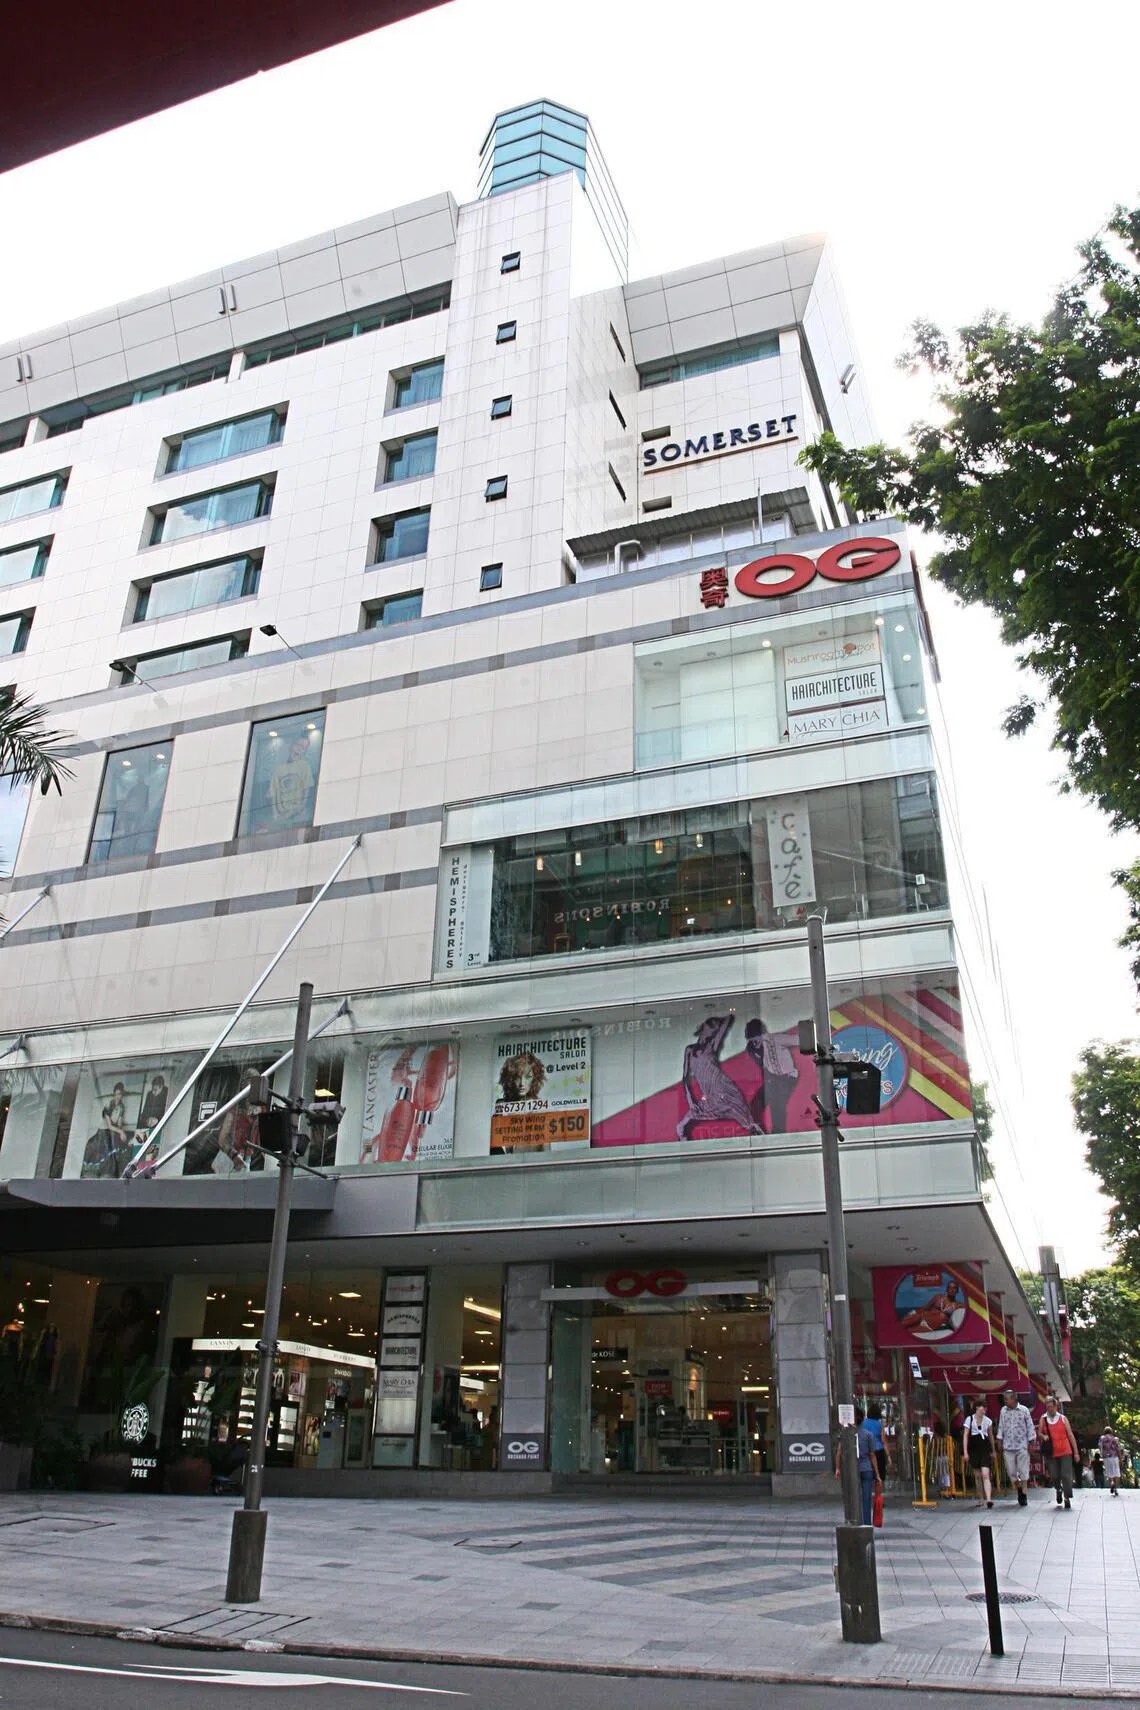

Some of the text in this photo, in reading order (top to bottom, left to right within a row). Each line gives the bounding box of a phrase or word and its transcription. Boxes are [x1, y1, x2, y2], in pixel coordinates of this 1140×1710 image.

[644, 414, 797, 467] SOMERSET
[735, 537, 901, 598] OG
[792, 672, 877, 700] HAIRCHITECTURE
[794, 711, 880, 733] MARY CHIA
[446, 857, 460, 969] HEMISPHERES
[498, 1037, 586, 1057] HAIRCHITECTURE
[556, 1063, 579, 1071] Level
[362, 1052, 378, 1132] LANCASTER
[504, 1100, 549, 1112] 6737 1294
[549, 1116, 585, 1135] $150
[605, 1270, 688, 1297] OG
[508, 1441, 539, 1453] OG
[789, 1443, 824, 1455] OG
[131, 1457, 157, 1467] BUCKS
